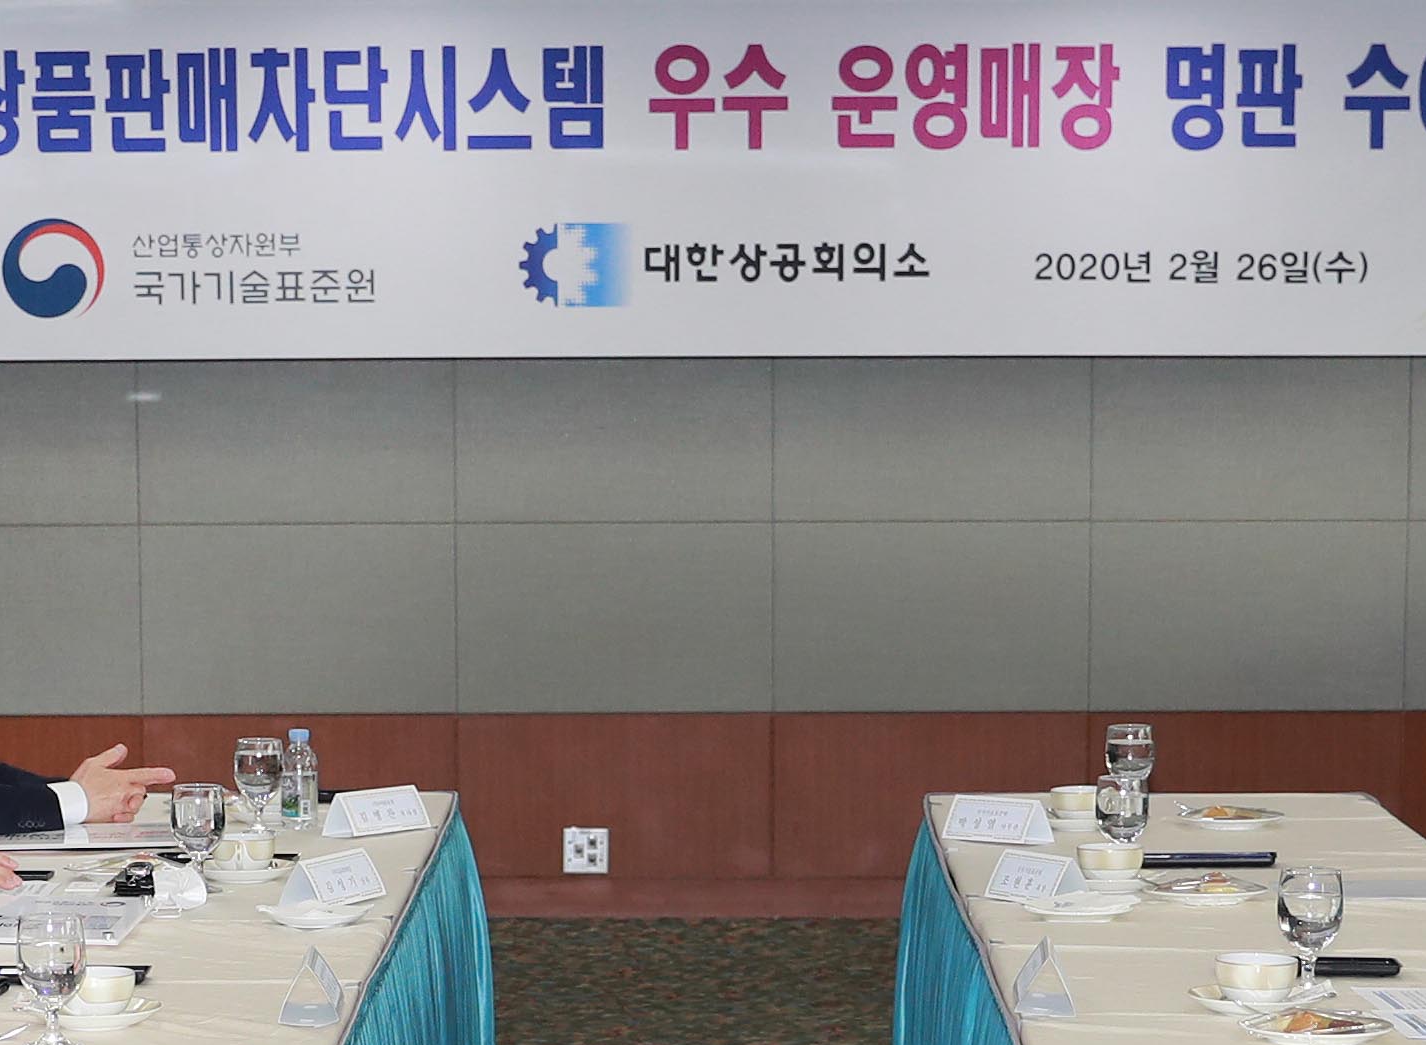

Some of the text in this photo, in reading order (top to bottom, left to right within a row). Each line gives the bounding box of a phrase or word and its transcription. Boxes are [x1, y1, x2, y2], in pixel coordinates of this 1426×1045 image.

[650, 45, 790, 151] 우수
[832, 44, 1121, 151] 운영매장
[1167, 44, 1304, 152] 명판
[132, 233, 302, 260] 산업통상자원부
[646, 243, 931, 283] 대한상공회의소
[1036, 251, 1369, 285] 2020년 2월 26일(수)
[133, 269, 377, 306] 국가기술표준원
